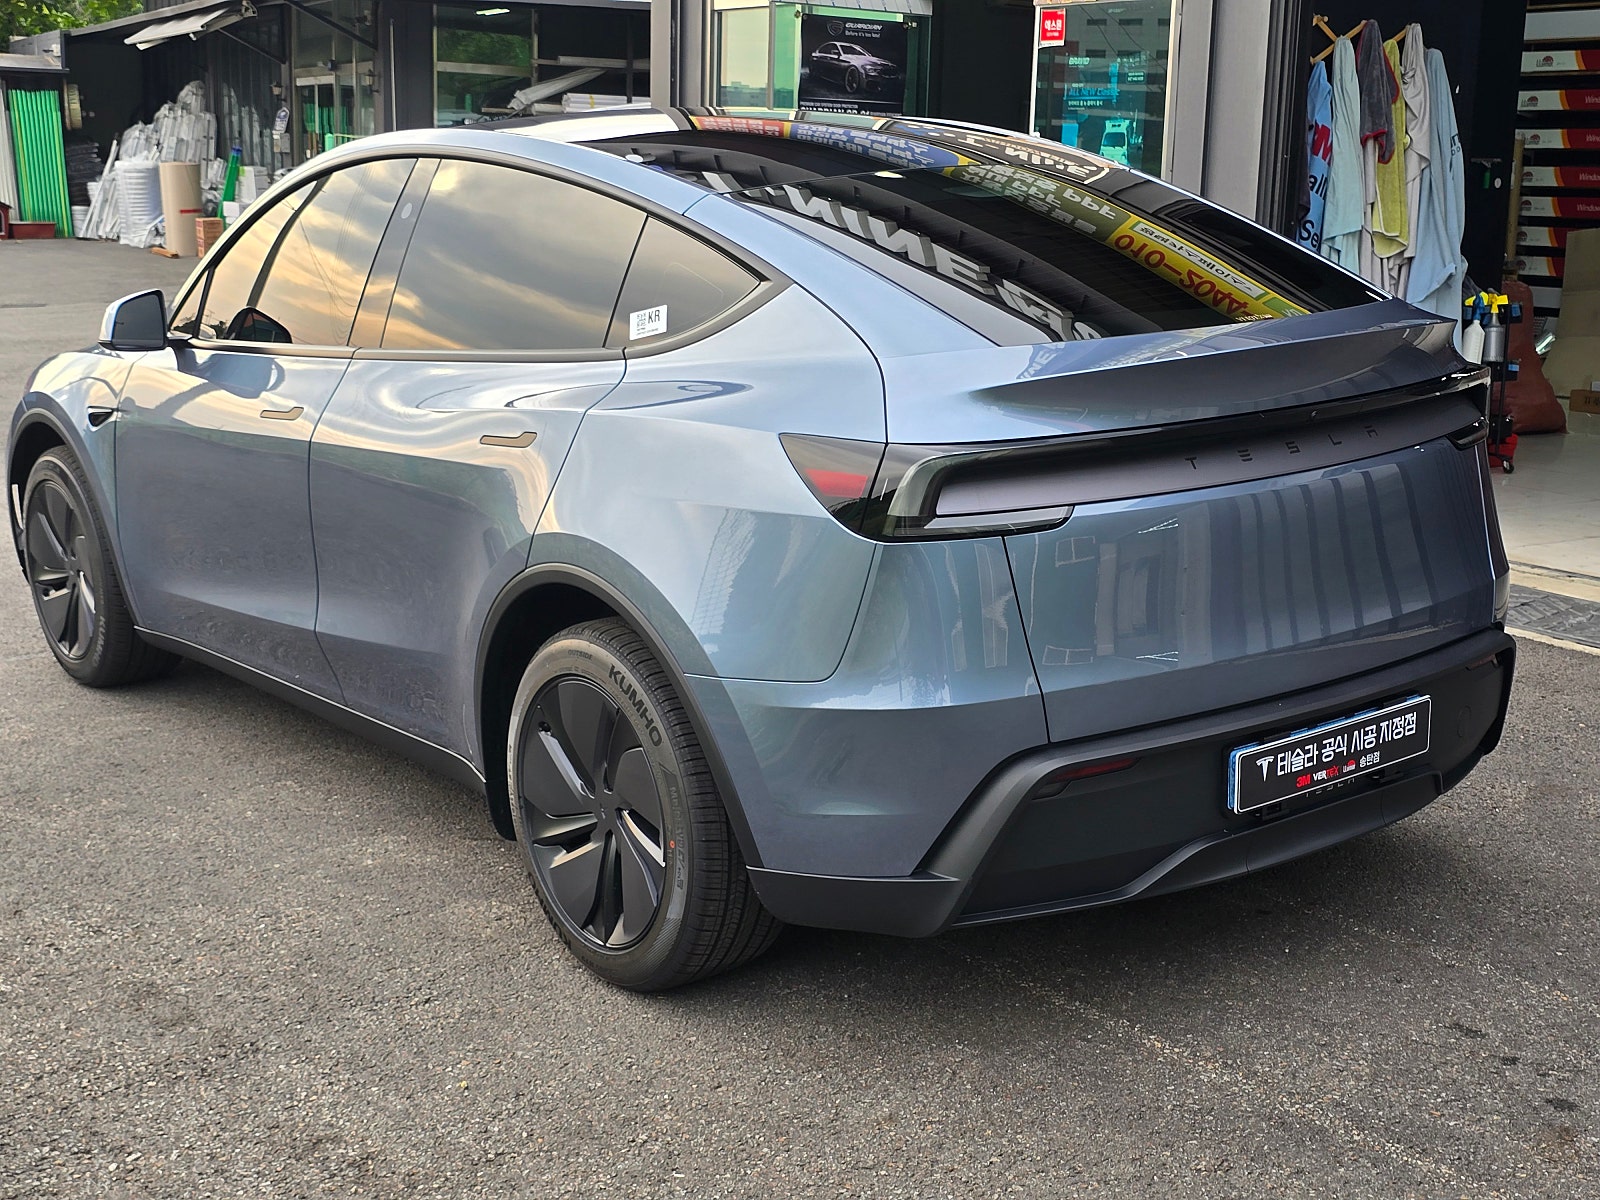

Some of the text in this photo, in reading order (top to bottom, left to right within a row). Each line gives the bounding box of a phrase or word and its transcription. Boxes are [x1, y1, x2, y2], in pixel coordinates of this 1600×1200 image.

[845, 22, 883, 31] GUARDIAN
[648, 310, 661, 324] KR
[1184, 425, 1379, 470] TESLA
[567, 649, 594, 662] OUTSIDE
[608, 664, 663, 748] KUMHO
[1277, 743, 1318, 776] 테슬라
[1322, 733, 1347, 763] 공식
[1351, 724, 1377, 753] 시공
[1379, 711, 1417, 744] 지정점
[1296, 773, 1311, 788] 3M
[1313, 765, 1340, 781] VERTEX
[1359, 751, 1380, 768] 송탄점
